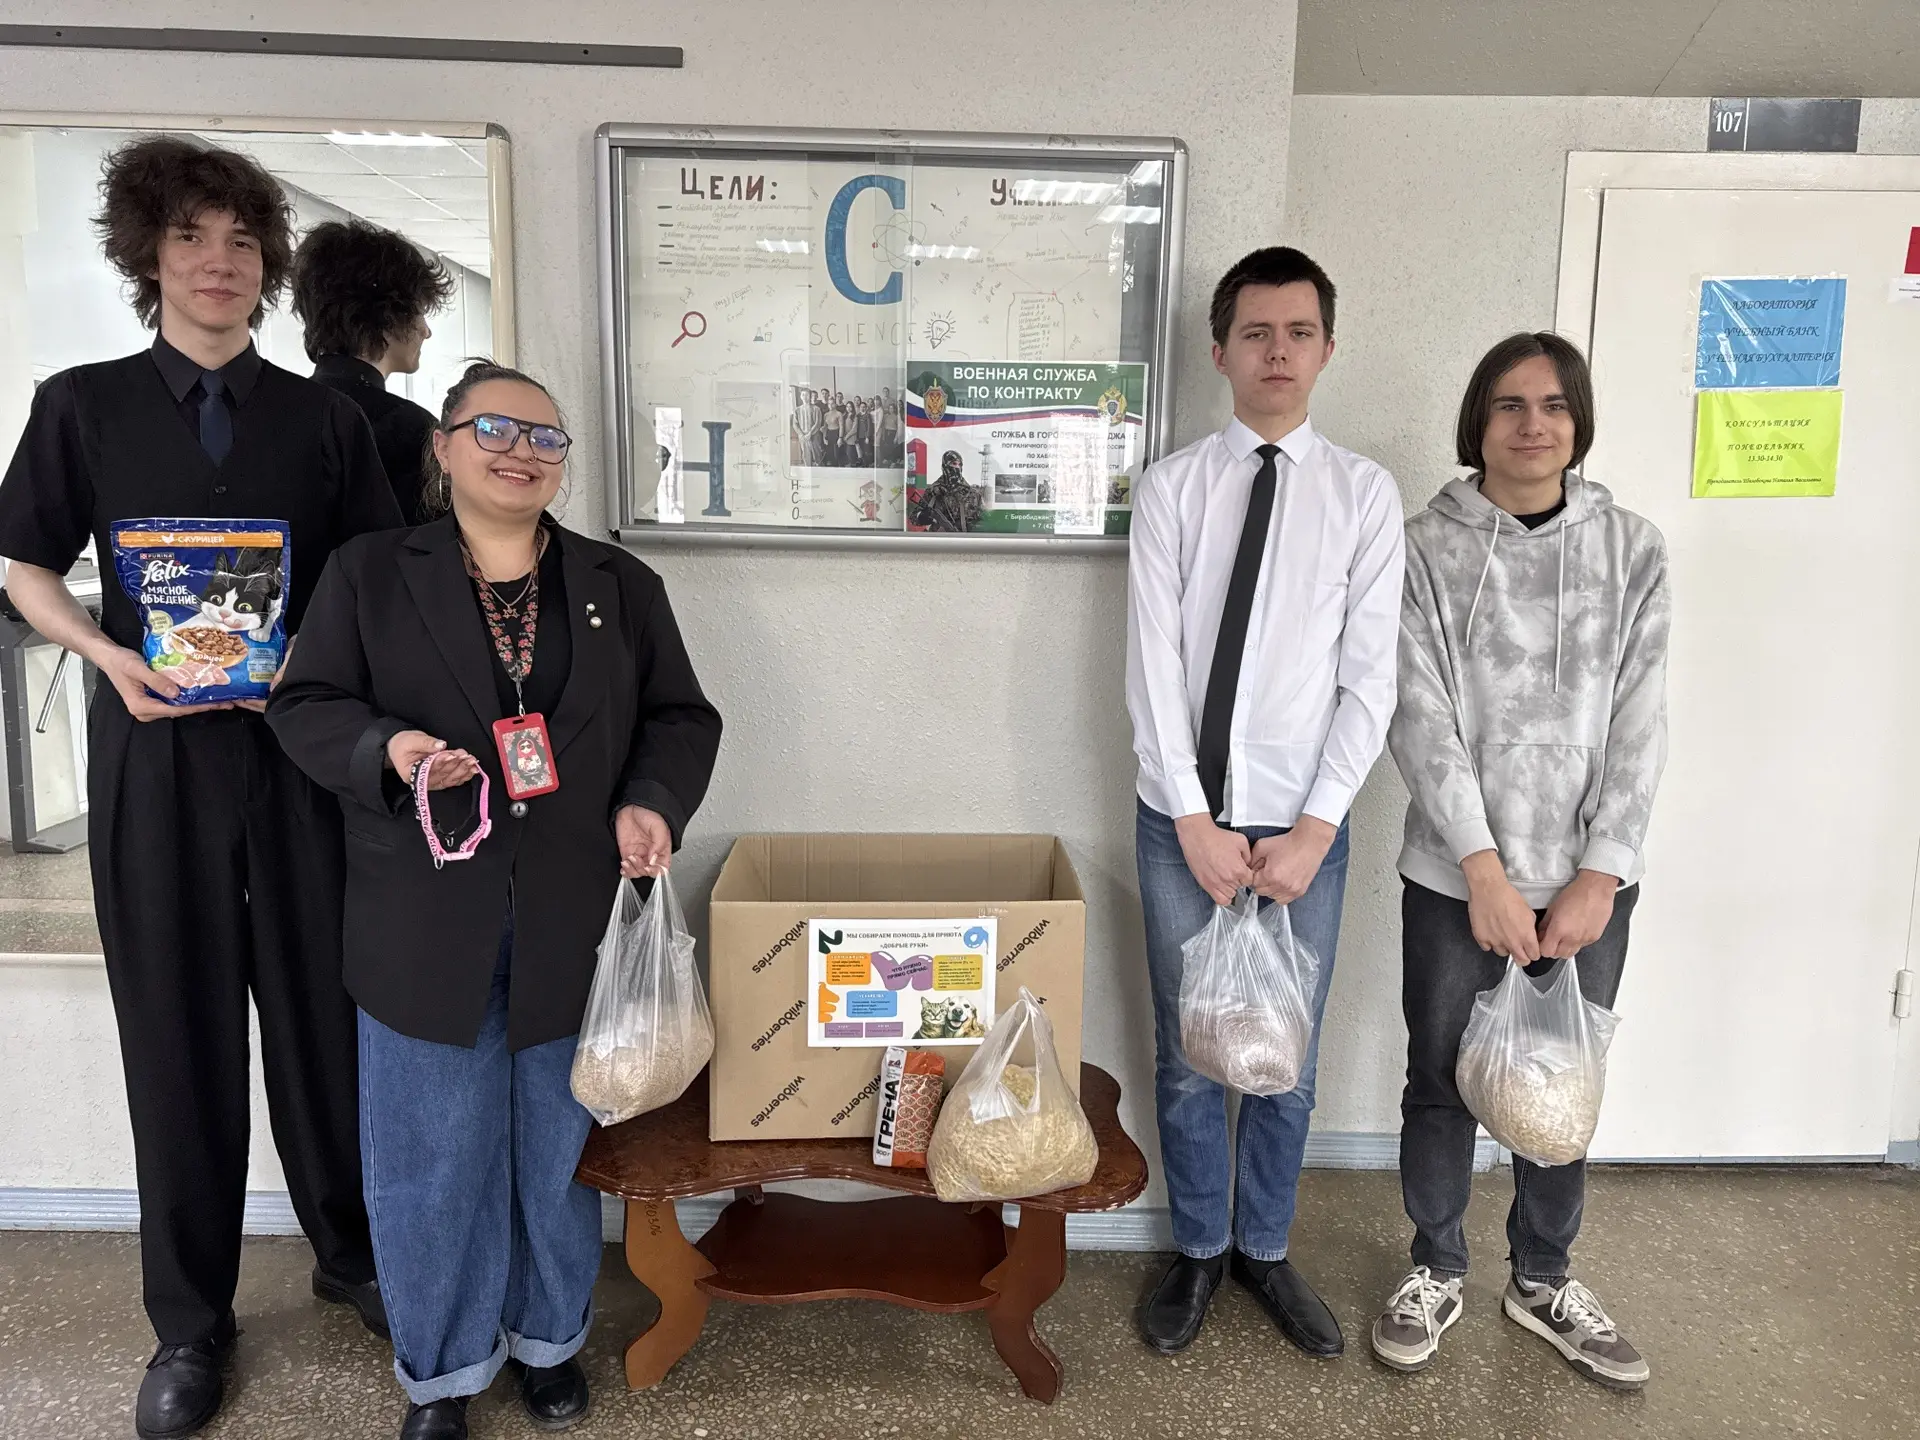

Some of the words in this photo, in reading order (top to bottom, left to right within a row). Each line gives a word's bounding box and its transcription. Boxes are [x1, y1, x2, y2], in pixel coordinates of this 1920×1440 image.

[1715, 111, 1742, 133] 107
[681, 167, 778, 202] ЦЕЛИ:
[1731, 298, 1818, 310] ЛАБОРАТОРИЯ
[809, 322, 917, 346] SCIENCE
[1787, 326, 1820, 337] БАНК
[1705, 353, 1756, 364] УЧЕНАЯ
[953, 367, 1028, 381] ВОЕННАЯ
[1033, 368, 1098, 382] СЛУЖБА
[967, 386, 992, 399] ПО
[995, 386, 1083, 400] КОНТРАКТУ
[1725, 419, 1811, 428] КОНСУЛЬТАЦИЯ
[991, 431, 1026, 439] СЛУЖБА
[1029, 431, 1035, 439] В
[1727, 443, 1805, 451] ПОНЕДЕЛЬНИК
[147, 585, 188, 595] МЯСНОЕ
[141, 593, 198, 605] ОБЪЕДЕНИЕ
[752, 920, 808, 974] wildberries
[996, 919, 1050, 972] wildberries
[751, 1000, 806, 1052] wildberries
[750, 1076, 805, 1127] wildberries
[878, 1080, 900, 1149] ГРЕЧА
